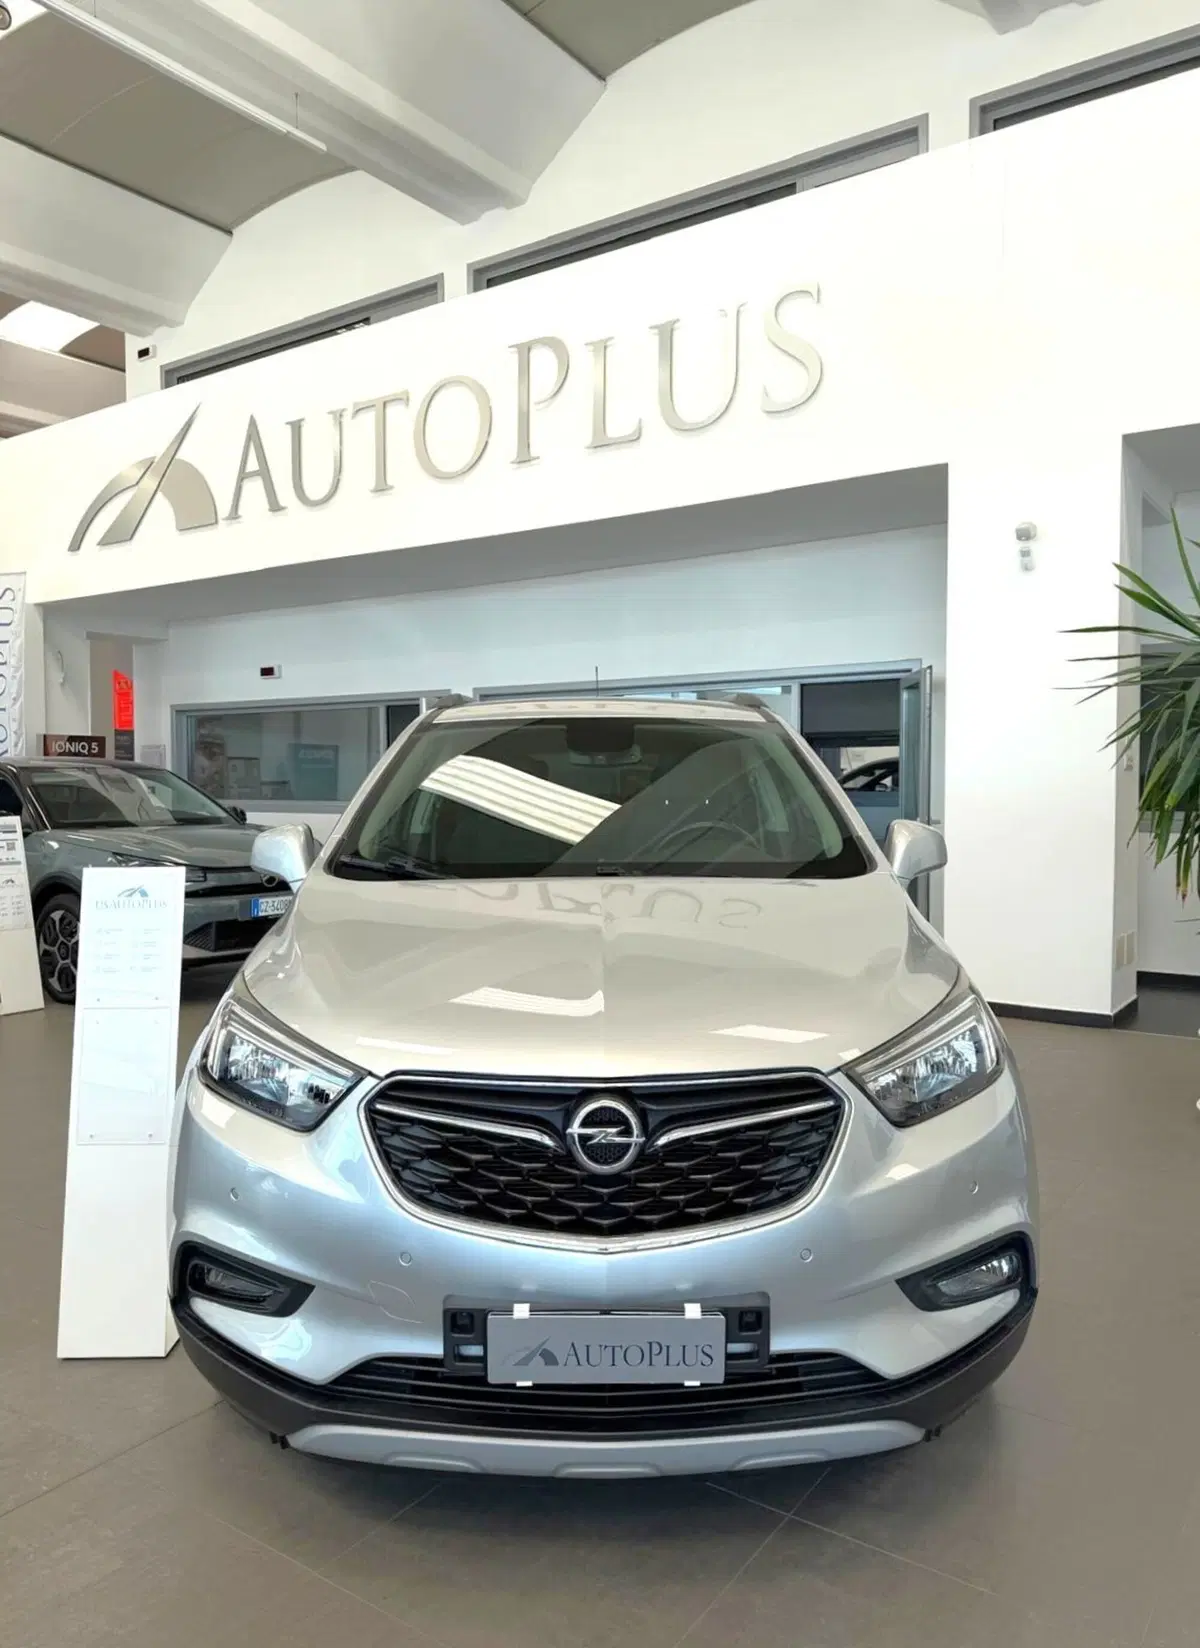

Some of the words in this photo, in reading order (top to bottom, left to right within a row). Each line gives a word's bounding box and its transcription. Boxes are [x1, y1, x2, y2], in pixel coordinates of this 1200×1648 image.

[222, 281, 824, 521] AUTOPLUS
[52, 741, 88, 755] IONIQ
[91, 742, 98, 753] 5
[563, 1340, 715, 1368] AUTOPLUS
